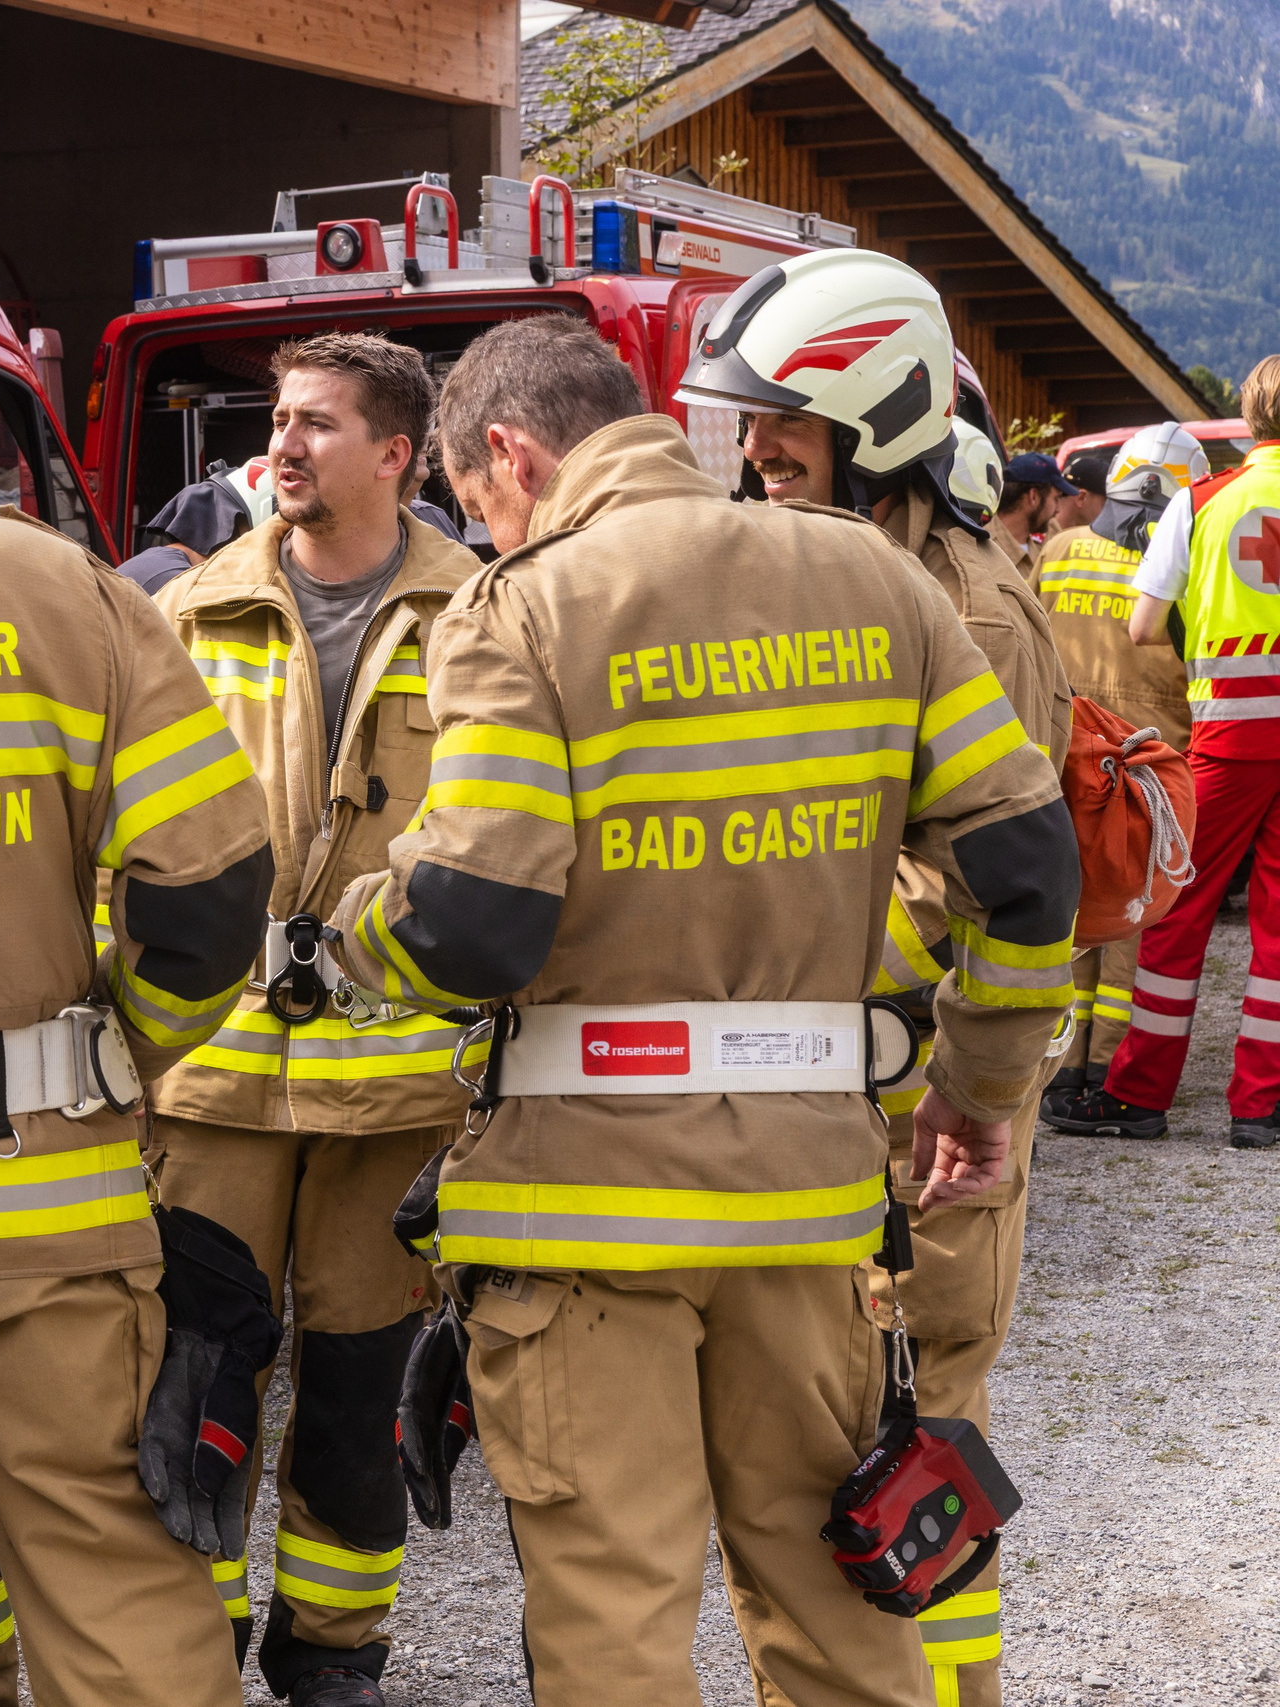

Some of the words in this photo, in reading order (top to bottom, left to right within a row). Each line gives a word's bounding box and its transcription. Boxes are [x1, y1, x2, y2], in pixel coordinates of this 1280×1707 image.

[1055, 591, 1095, 616] AFK
[609, 626, 893, 710] FEUERWEHR
[601, 816, 706, 871] BAD
[722, 791, 882, 865] GASTEIN
[612, 1044, 685, 1056] rosenbauer
